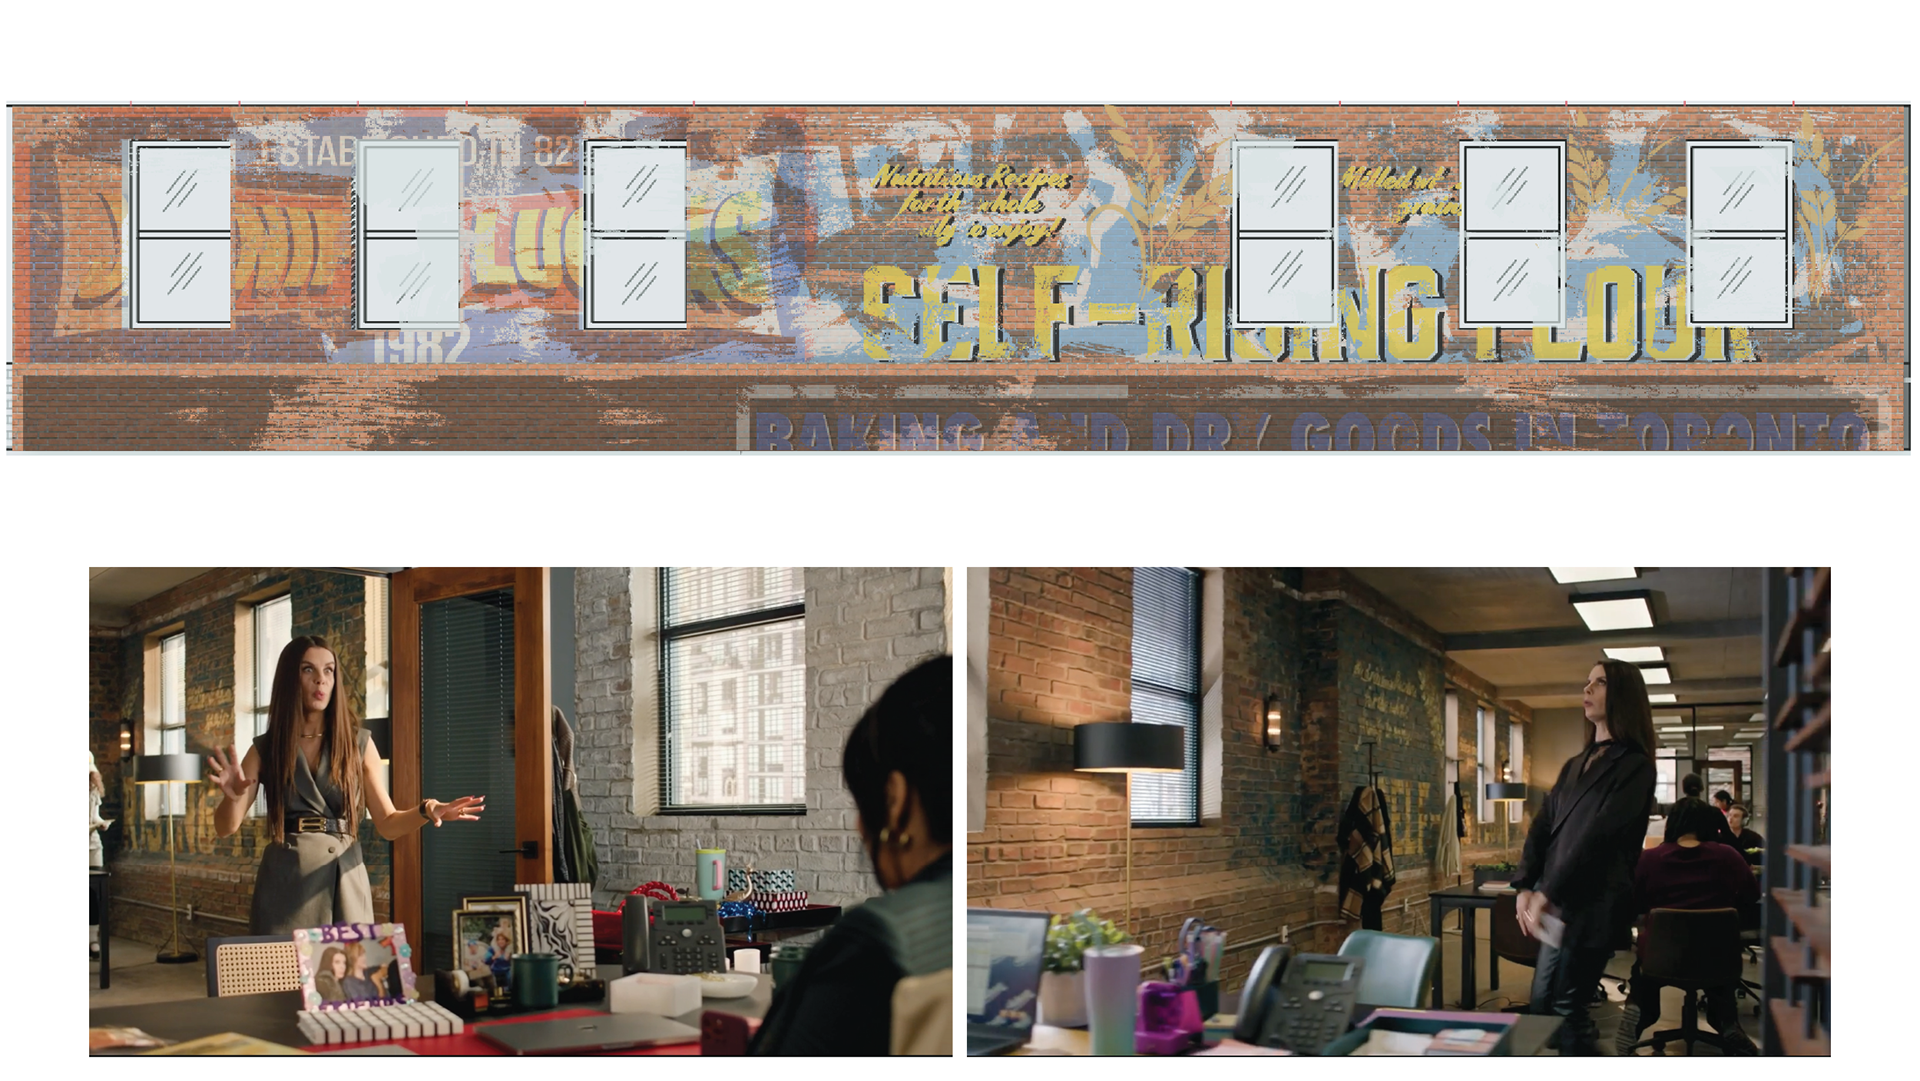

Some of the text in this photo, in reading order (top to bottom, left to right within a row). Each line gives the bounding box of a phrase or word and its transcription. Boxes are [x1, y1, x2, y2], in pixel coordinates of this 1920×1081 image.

[535, 135, 573, 167] 82
[987, 164, 1073, 190] Recipes
[987, 216, 1066, 247] enjoy!
[374, 323, 471, 364] 1982
[756, 412, 985, 450] BAKING
[1291, 412, 1492, 450] GOODS
[321, 921, 376, 943] BEST
